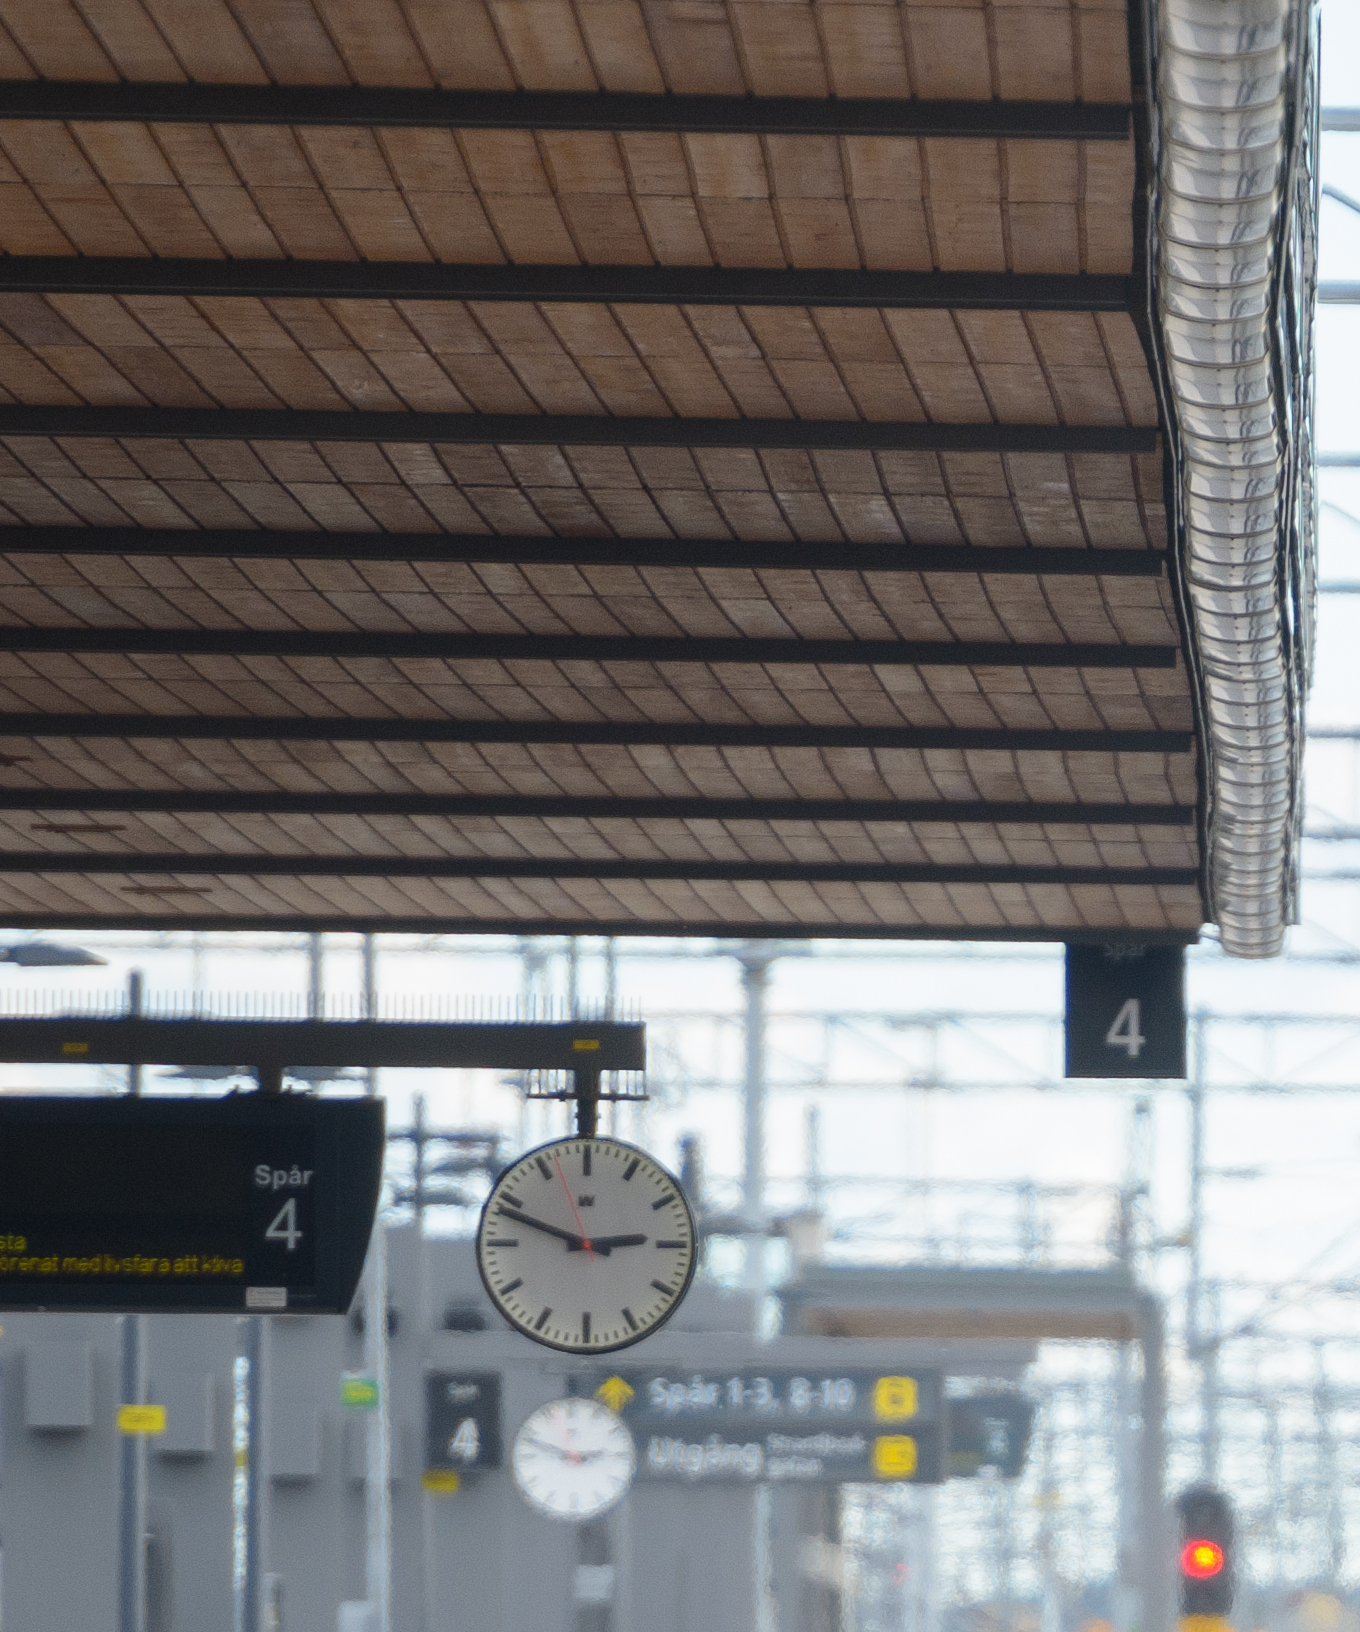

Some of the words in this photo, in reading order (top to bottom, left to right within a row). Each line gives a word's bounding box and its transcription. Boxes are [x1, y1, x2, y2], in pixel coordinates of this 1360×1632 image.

[1105, 998, 1145, 1056] 4
[254, 1164, 313, 1189] Spår
[265, 1198, 303, 1250] 4
[449, 1418, 479, 1462] 4
